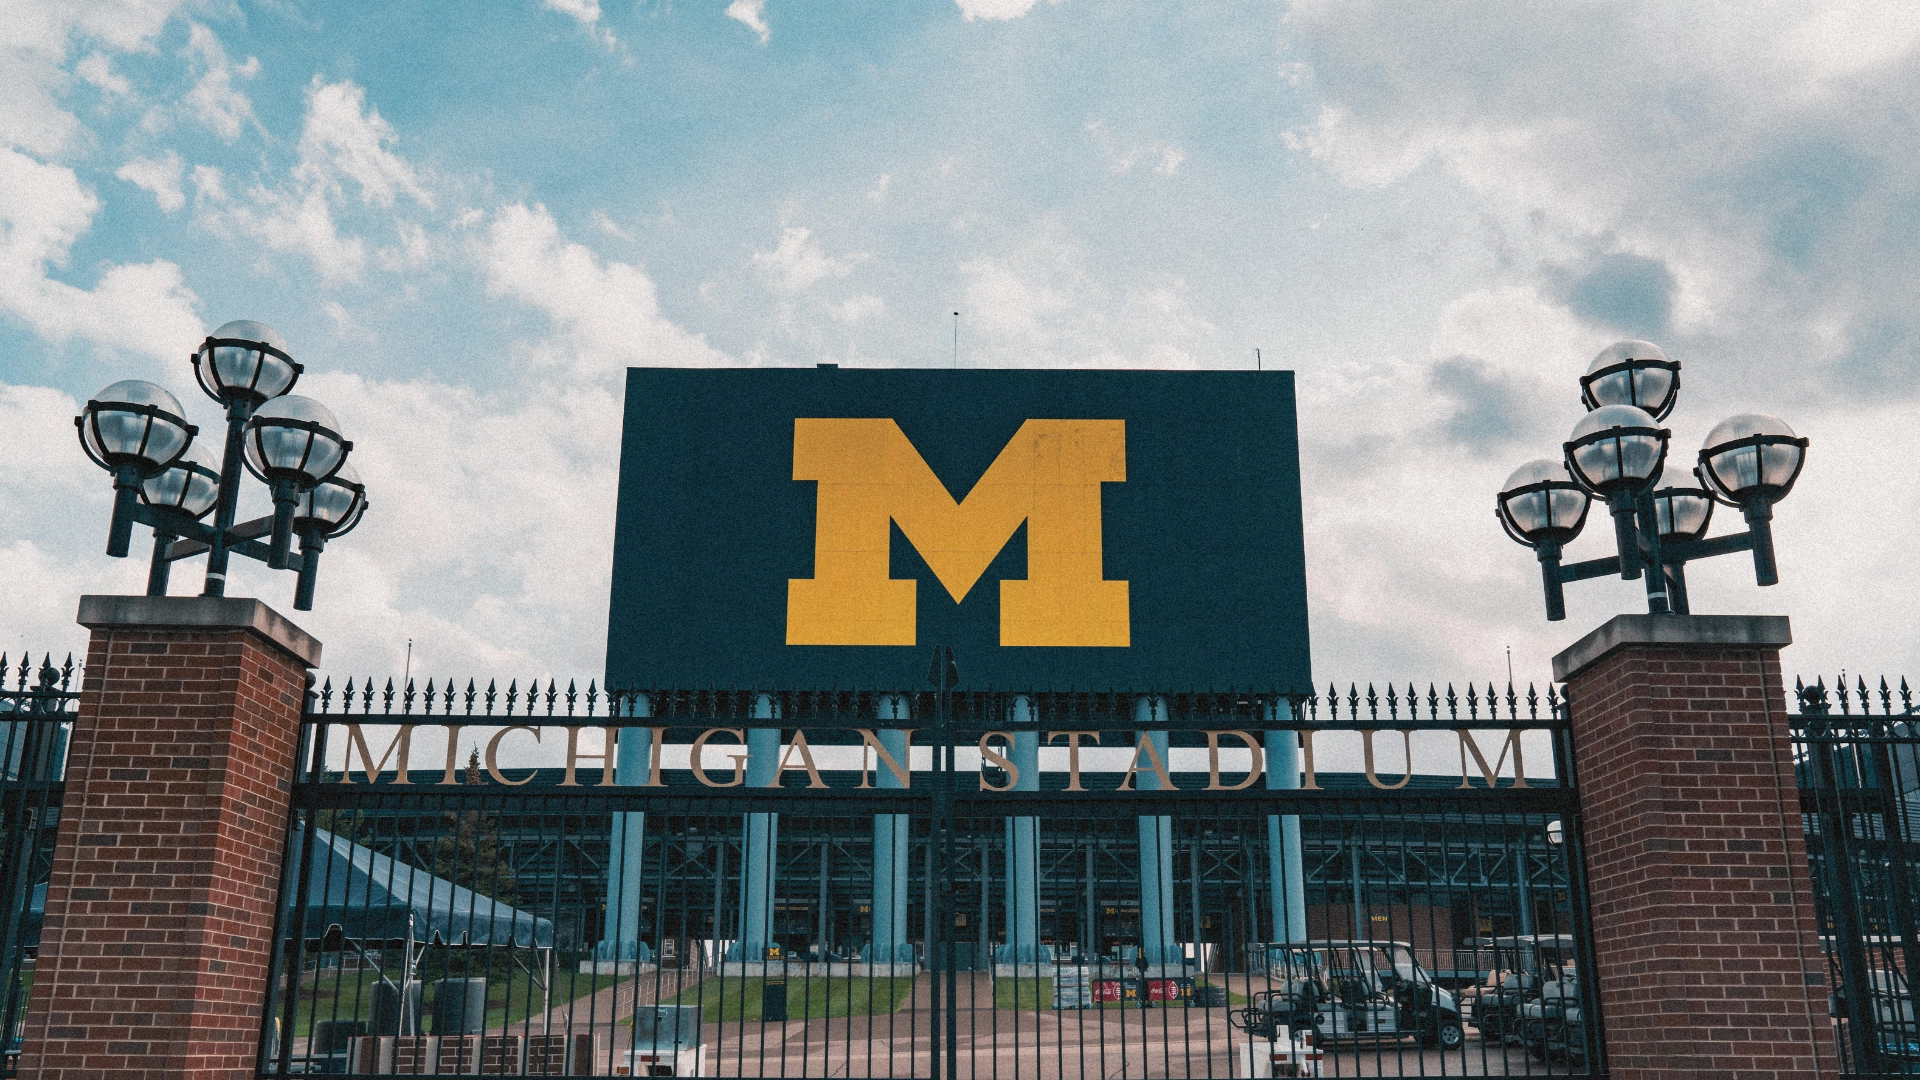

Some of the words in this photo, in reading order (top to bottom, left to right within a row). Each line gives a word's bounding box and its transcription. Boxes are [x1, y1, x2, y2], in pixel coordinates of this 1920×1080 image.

[785, 417, 1131, 647] M
[340, 724, 916, 790] MICHIGAN
[978, 729, 1529, 792] STADIUM
[769, 948, 780, 956] M
[1125, 989, 1137, 998] M
